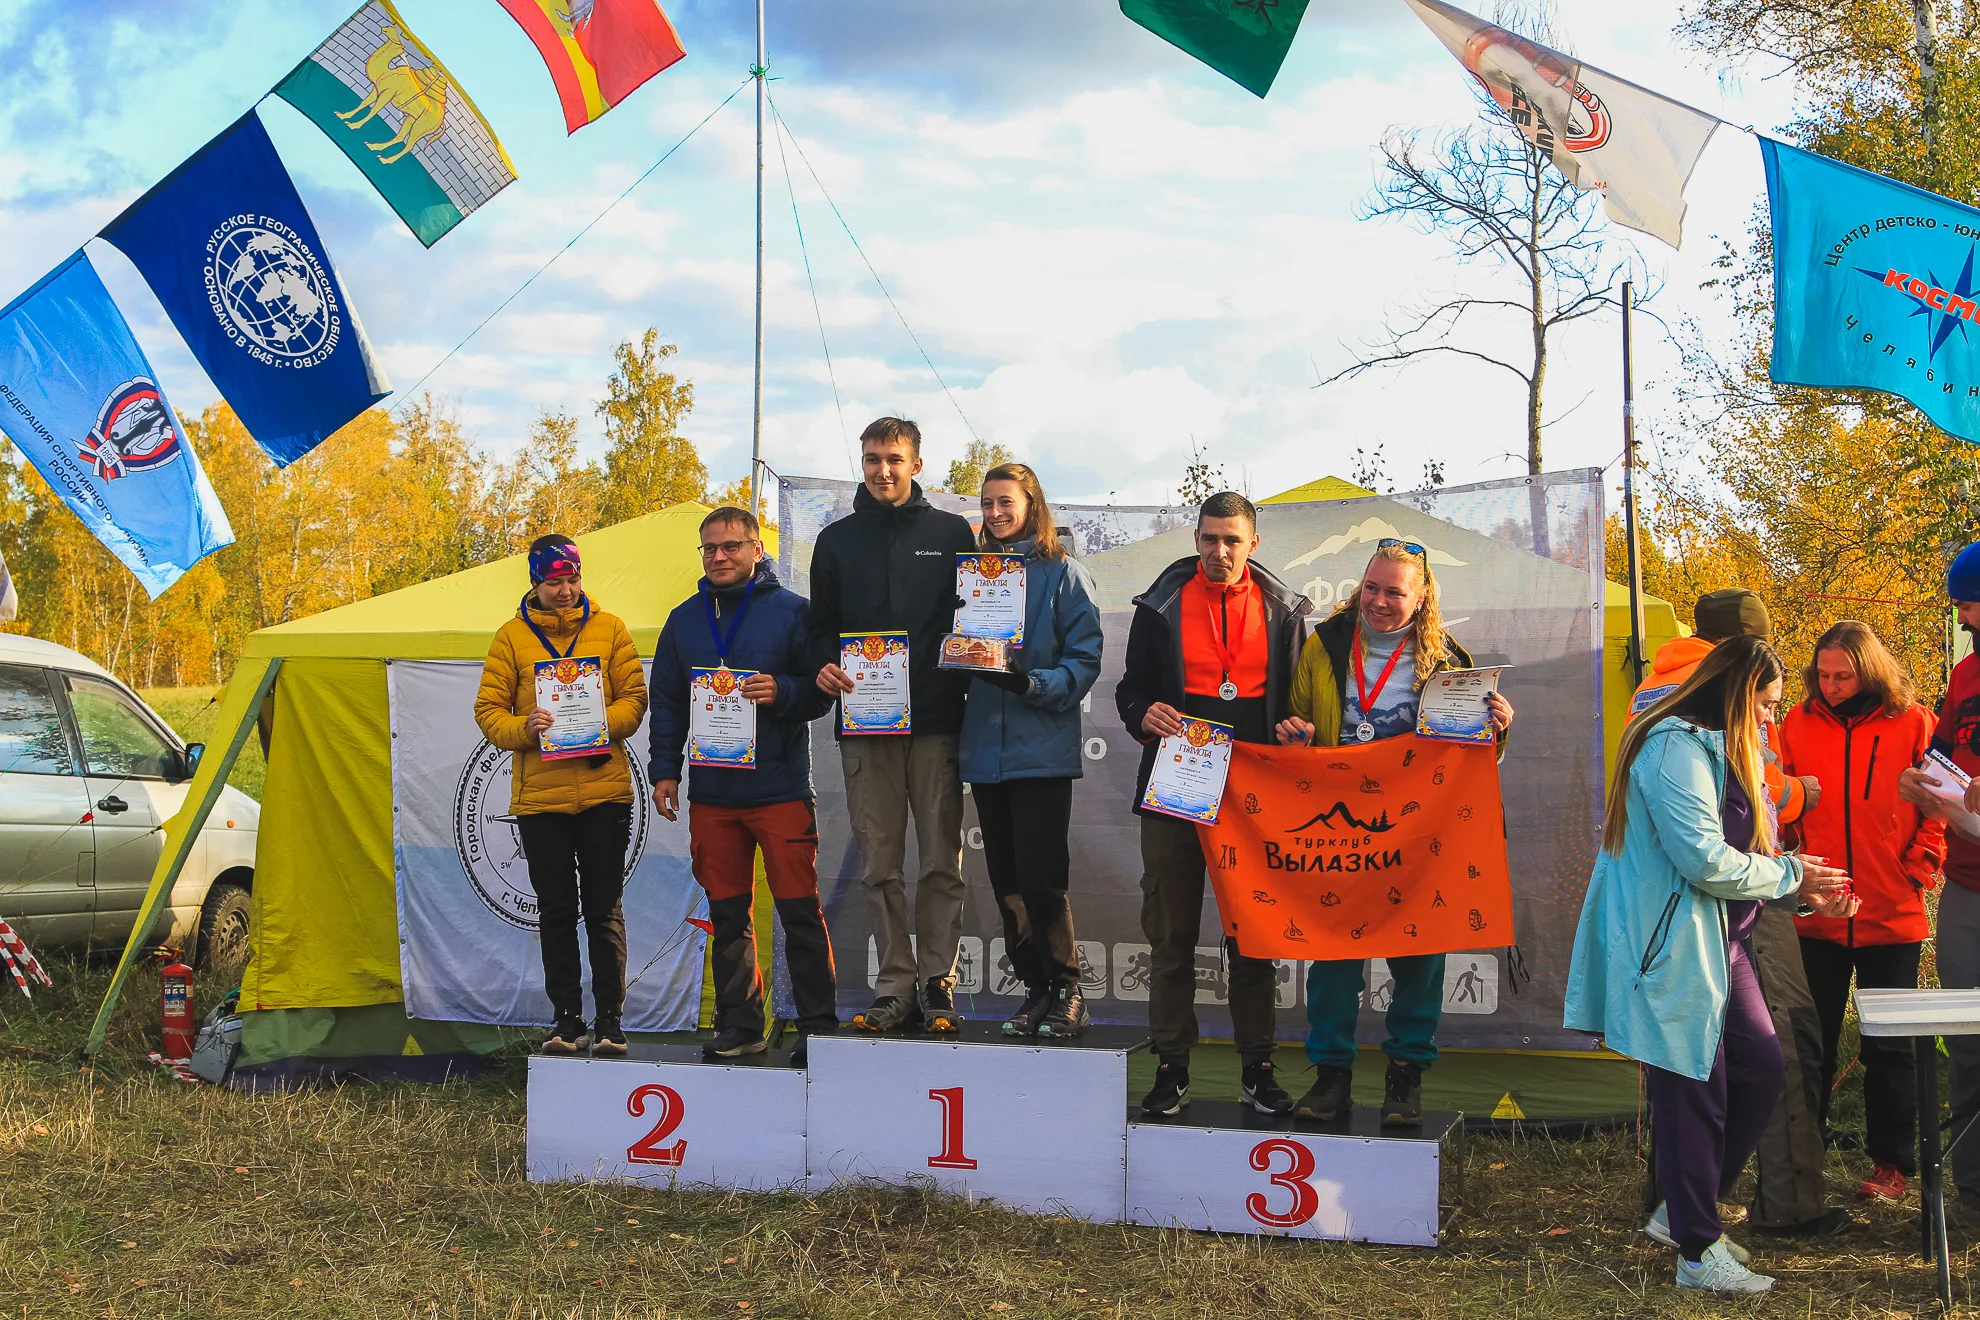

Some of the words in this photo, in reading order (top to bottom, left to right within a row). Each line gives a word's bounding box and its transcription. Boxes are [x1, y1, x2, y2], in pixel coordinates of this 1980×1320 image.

[206, 214, 255, 253] РУССКОЕ
[1823, 223, 1870, 268] Центр
[1875, 216, 1937, 232] детско
[259, 215, 339, 312] ГЕОГРАФИЧЕСКОЕ
[204, 266, 238, 338] ОСНОВАНО
[235, 337, 247, 348] В
[247, 344, 274, 365] 1845
[275, 358, 283, 368] г.
[293, 315, 341, 369] ОБЩЕСТВО
[0, 383, 54, 445] ФЕДЕРАЦИЯ
[52, 444, 113, 522] СПОРТИВНОГО
[99, 445, 116, 465] 1895
[49, 459, 89, 504] РОССИИ
[975, 579, 1008, 587] ГРАМОТА
[553, 683, 585, 692] ГРАМОТА
[859, 661, 890, 669] ГРАМОТА
[708, 695, 739, 704] ГРАМОТА
[1179, 743, 1213, 759] ГРАМОТА
[467, 777, 484, 864] Городская
[1295, 834, 1372, 849] турклуб
[501, 890, 510, 904] г.
[625, 1084, 689, 1167] 2
[927, 1086, 978, 1171] 1
[1245, 1138, 1319, 1228] 3
